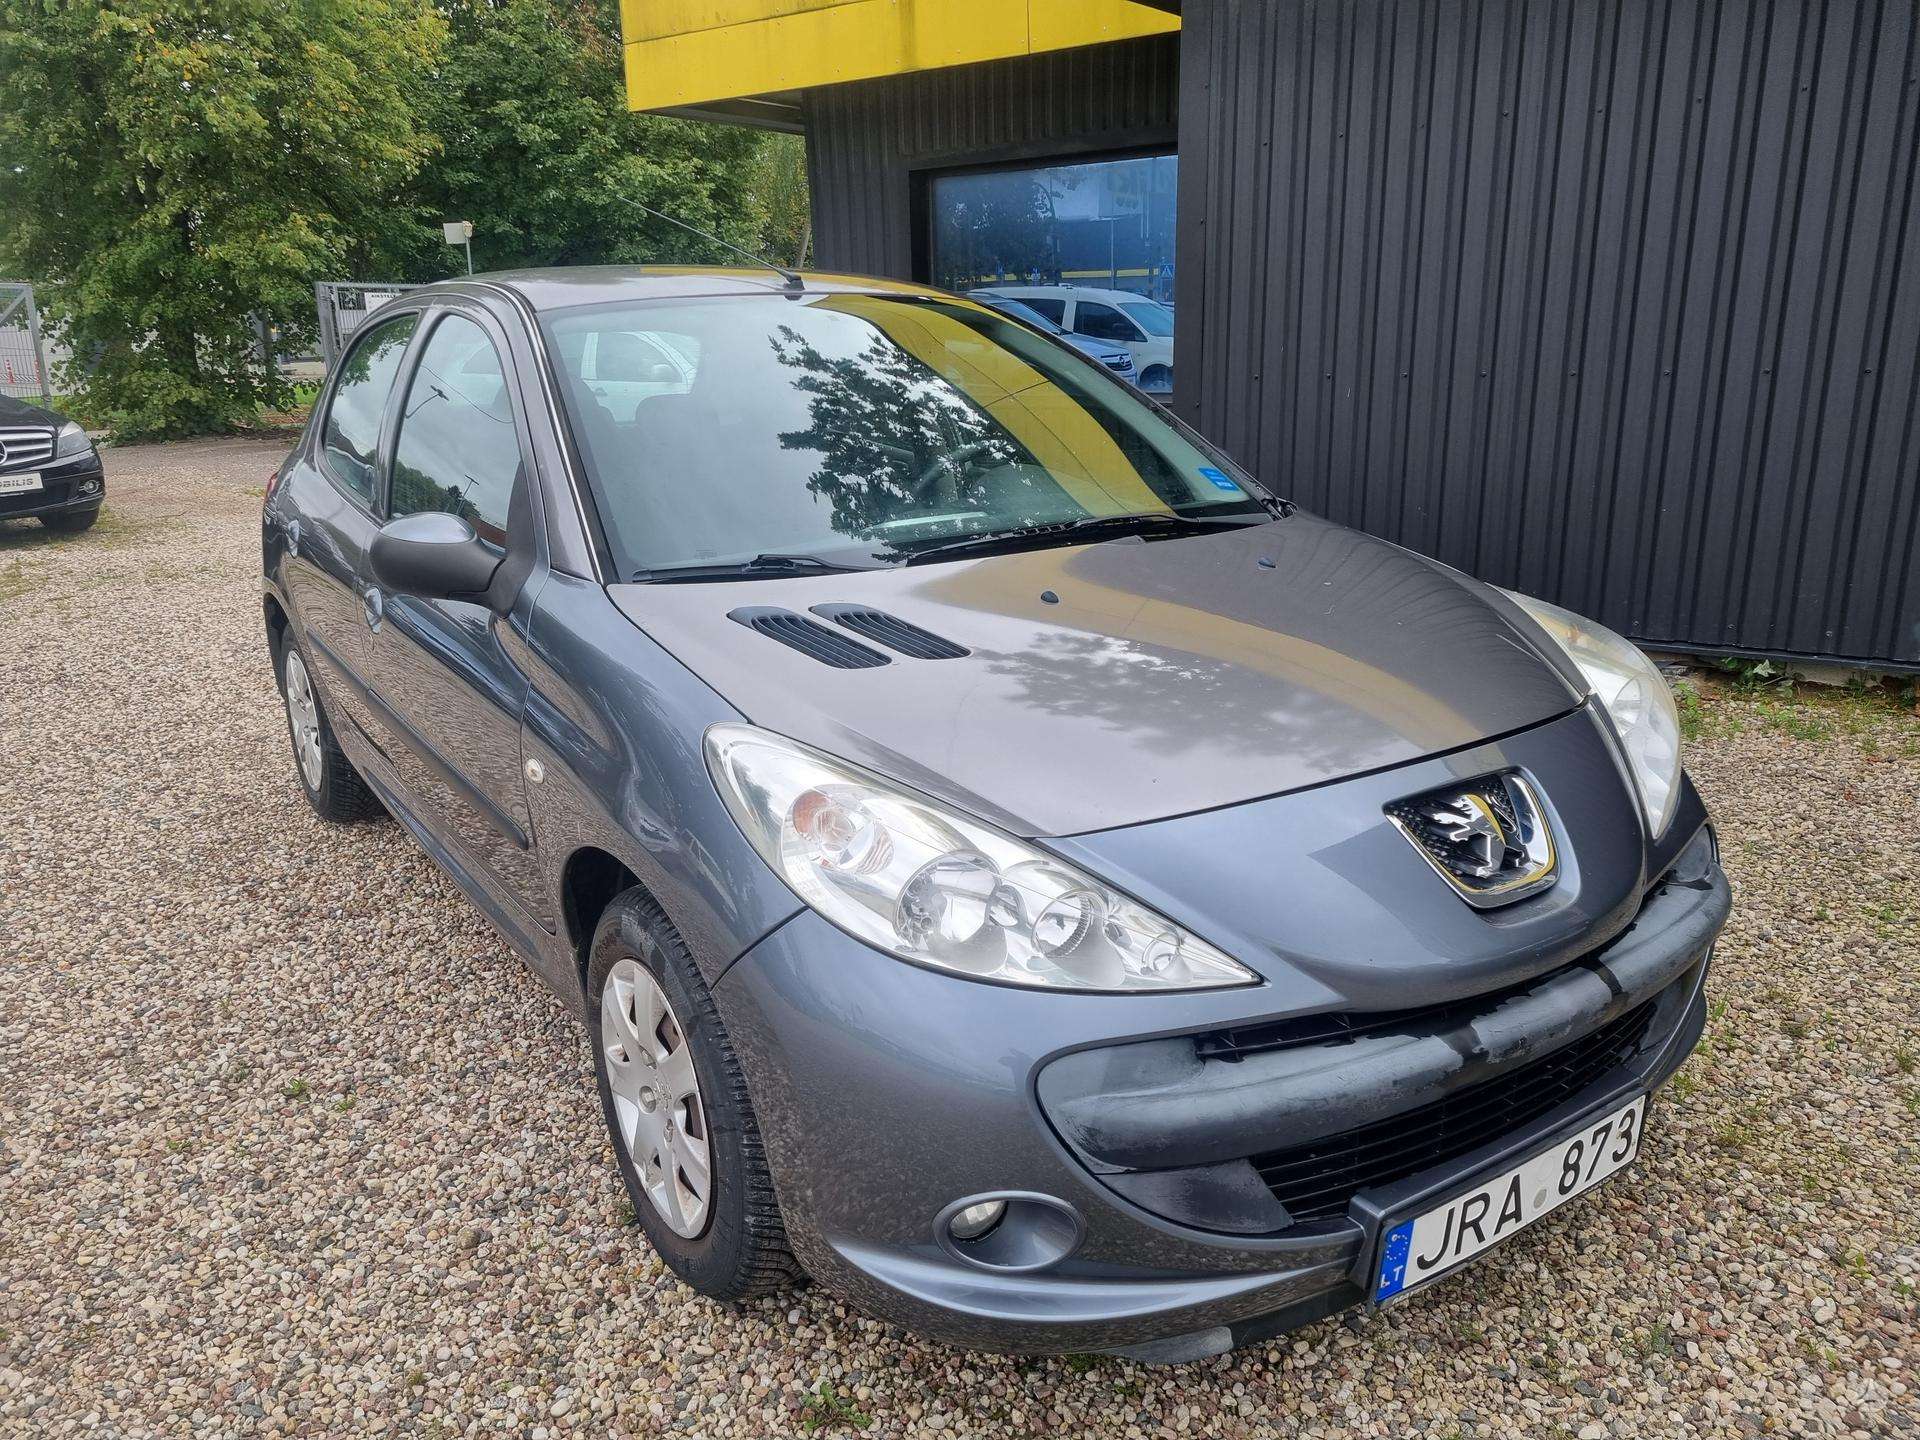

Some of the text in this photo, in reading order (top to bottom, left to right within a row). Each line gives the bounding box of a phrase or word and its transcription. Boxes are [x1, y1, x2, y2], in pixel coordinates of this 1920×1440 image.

[1416, 1108, 1636, 1270] JRA 873
[1380, 1265, 1404, 1288] LT
